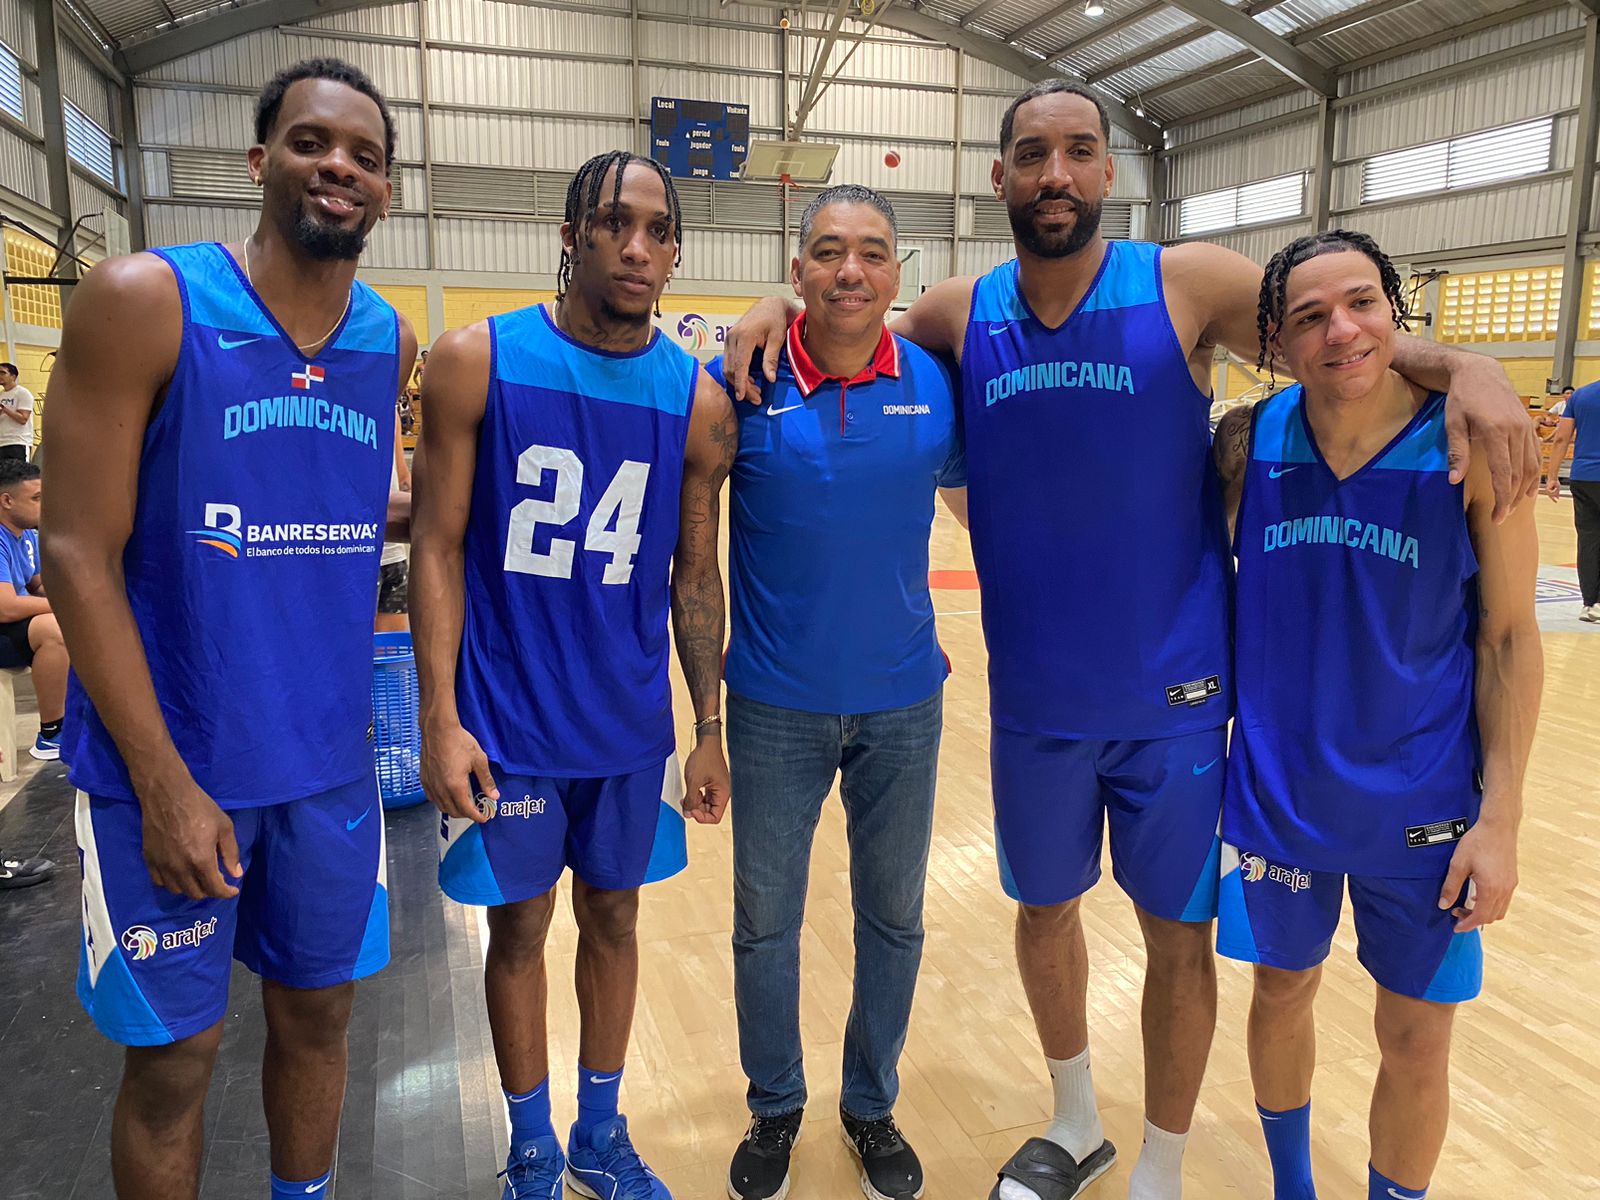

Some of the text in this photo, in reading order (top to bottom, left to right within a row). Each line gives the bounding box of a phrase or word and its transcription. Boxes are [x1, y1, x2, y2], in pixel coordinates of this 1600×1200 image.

[657, 99, 675, 109] Local
[986, 361, 1135, 407] DOMINICANA
[882, 404, 931, 416] DOMINICANA
[223, 395, 378, 450] DOMINICANA
[503, 444, 651, 585] 24
[246, 547, 255, 557] El
[256, 547, 283, 557] banco
[283, 545, 294, 555] de
[295, 545, 320, 555] todos
[321, 545, 335, 555] los
[1263, 516, 1419, 569] DOMINICANA
[1207, 681, 1217, 690] XL
[500, 795, 546, 819] arajet
[1455, 823, 1465, 833] M
[162, 916, 217, 950] arajet
